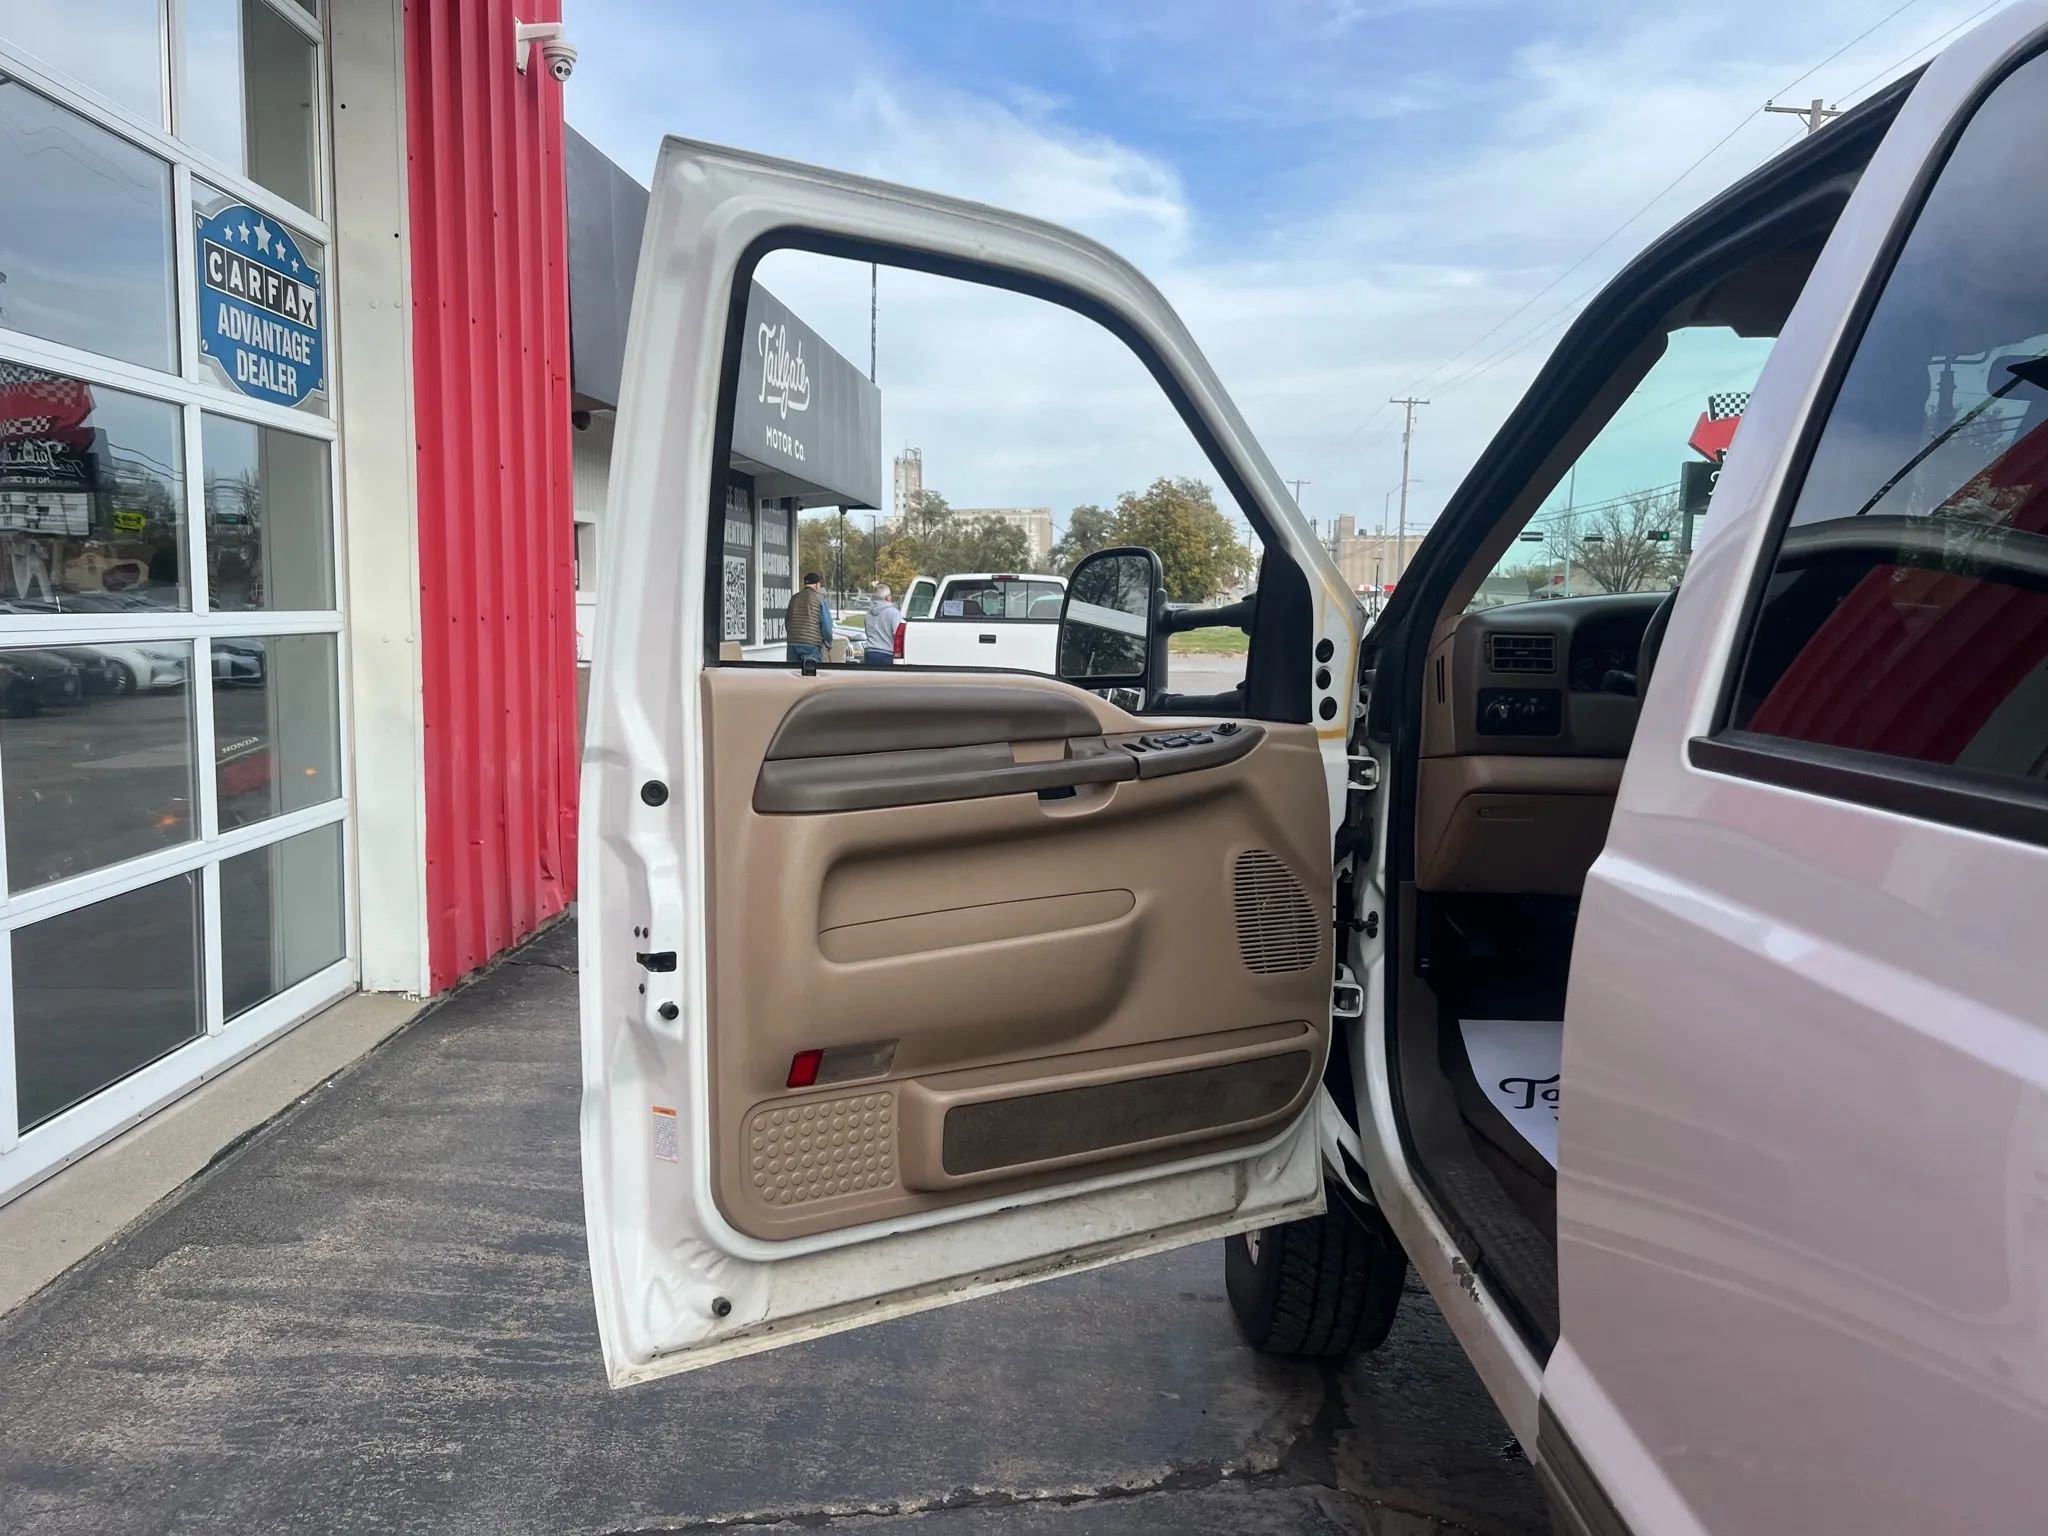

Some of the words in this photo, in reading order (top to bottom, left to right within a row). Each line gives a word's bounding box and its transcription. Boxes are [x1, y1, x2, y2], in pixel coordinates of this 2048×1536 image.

[209, 251, 314, 327] CARFAX
[217, 302, 311, 366] ADVANTAGE
[236, 348, 298, 398] DEALER
[758, 322, 810, 420] Tailgate
[766, 425, 793, 457] MOTOR
[794, 439, 806, 462] CO.
[221, 736, 260, 754] HONDA
